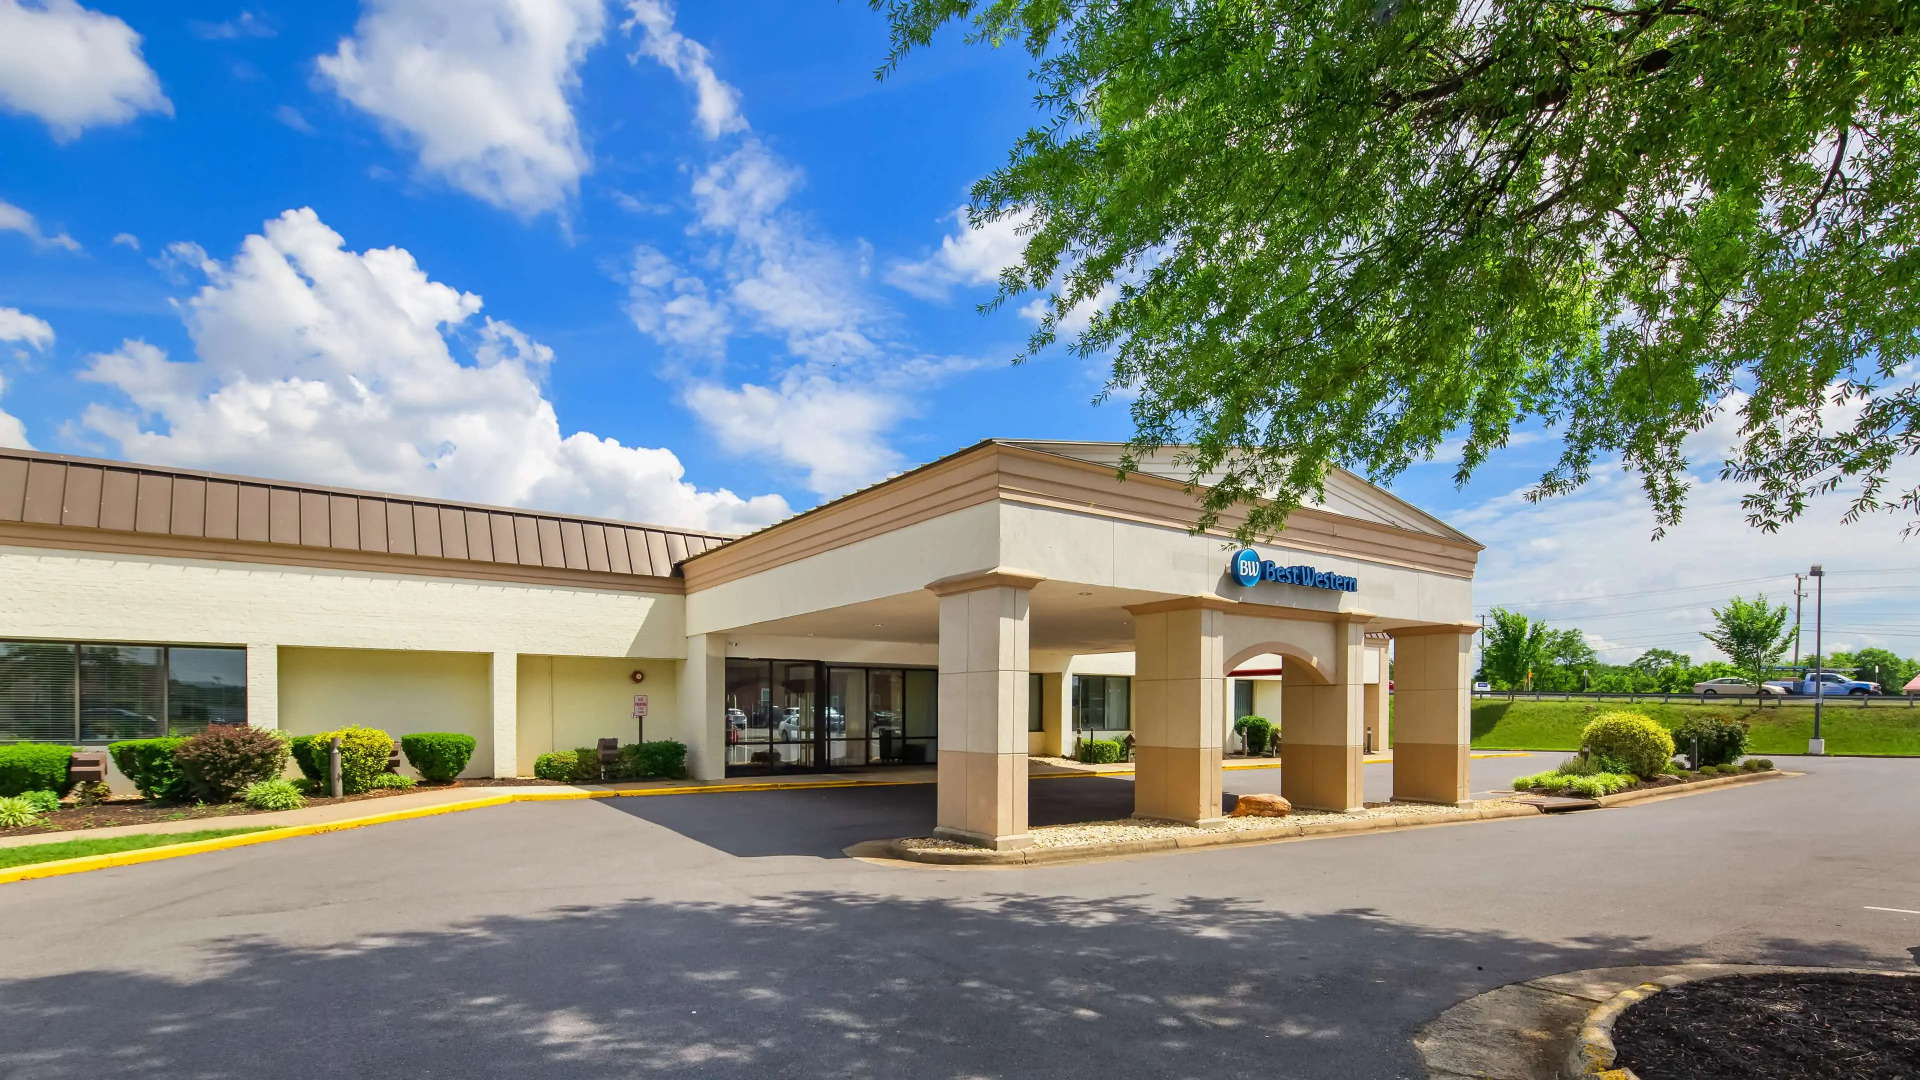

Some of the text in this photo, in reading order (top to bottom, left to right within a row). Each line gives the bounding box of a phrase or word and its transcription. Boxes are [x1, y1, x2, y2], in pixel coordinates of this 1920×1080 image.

[1240, 560, 1259, 576] BW
[1265, 561, 1357, 592] Best Western
